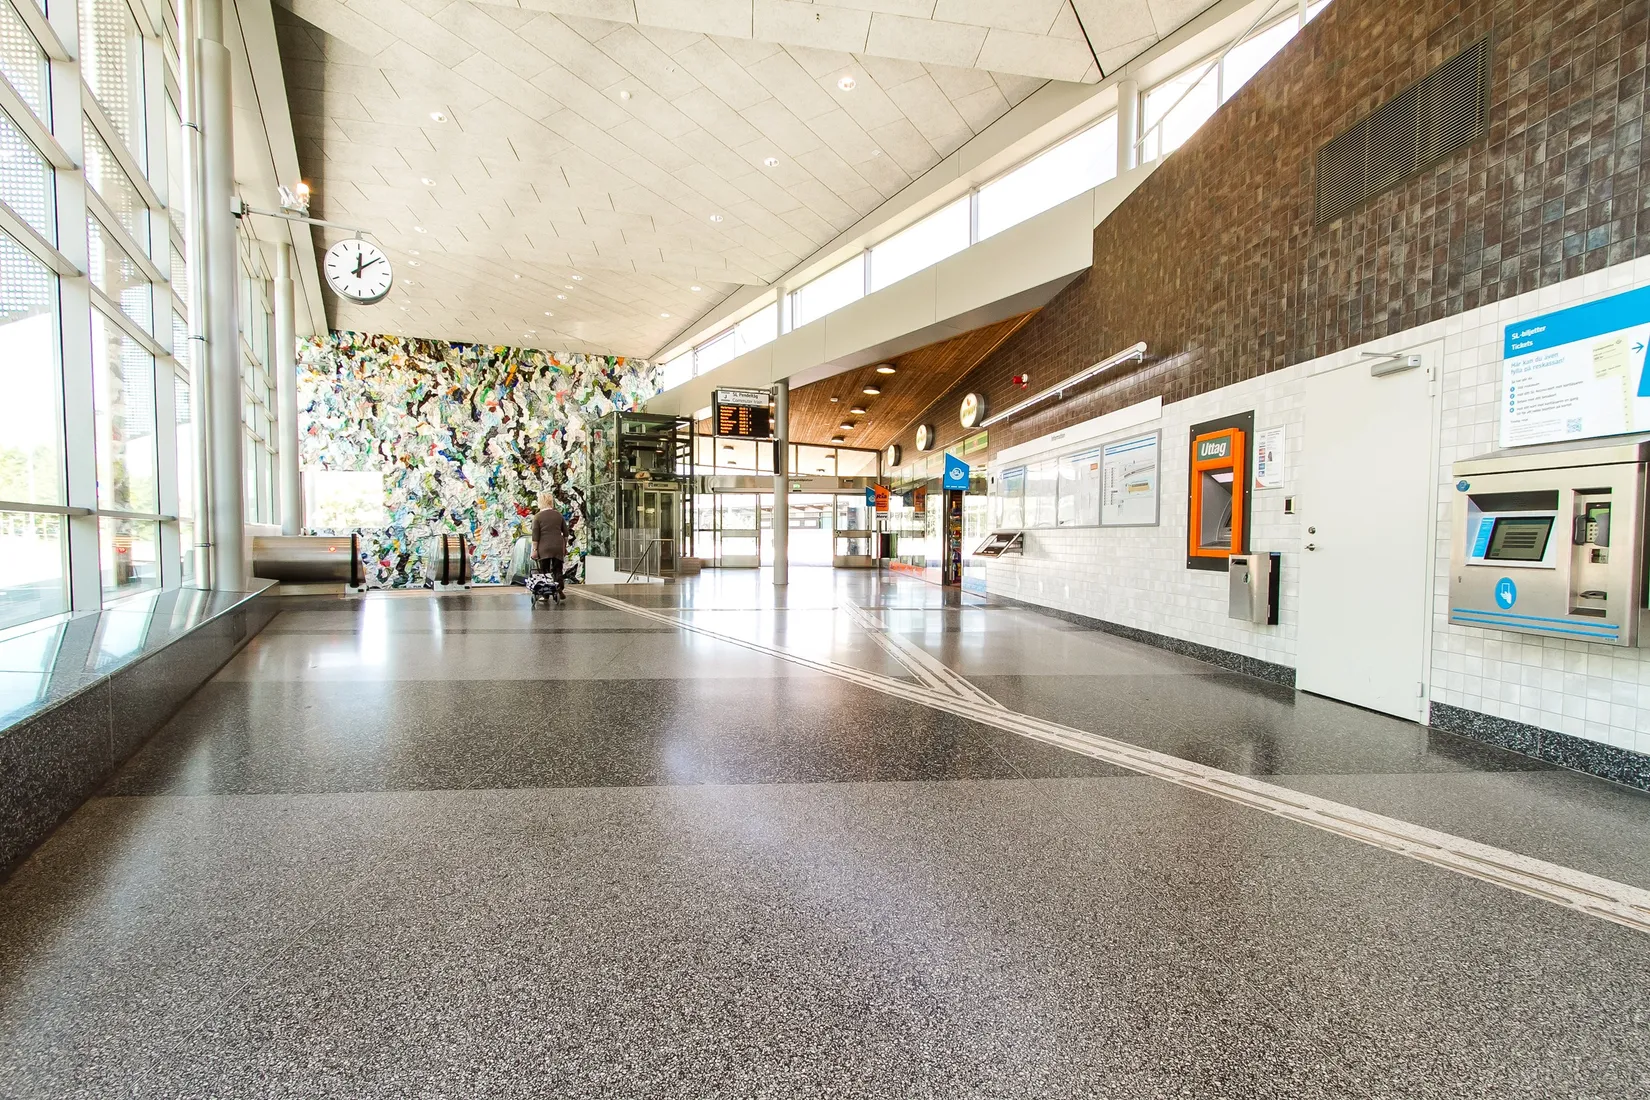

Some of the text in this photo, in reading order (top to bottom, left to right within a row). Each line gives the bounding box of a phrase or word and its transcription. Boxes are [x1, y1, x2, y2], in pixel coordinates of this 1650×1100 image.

[1511, 325, 1547, 340] SL-biljetter
[1511, 340, 1534, 351] Tickets
[1522, 358, 1534, 366] kan
[1534, 355, 1543, 363] du
[1201, 442, 1227, 457] Uttag
